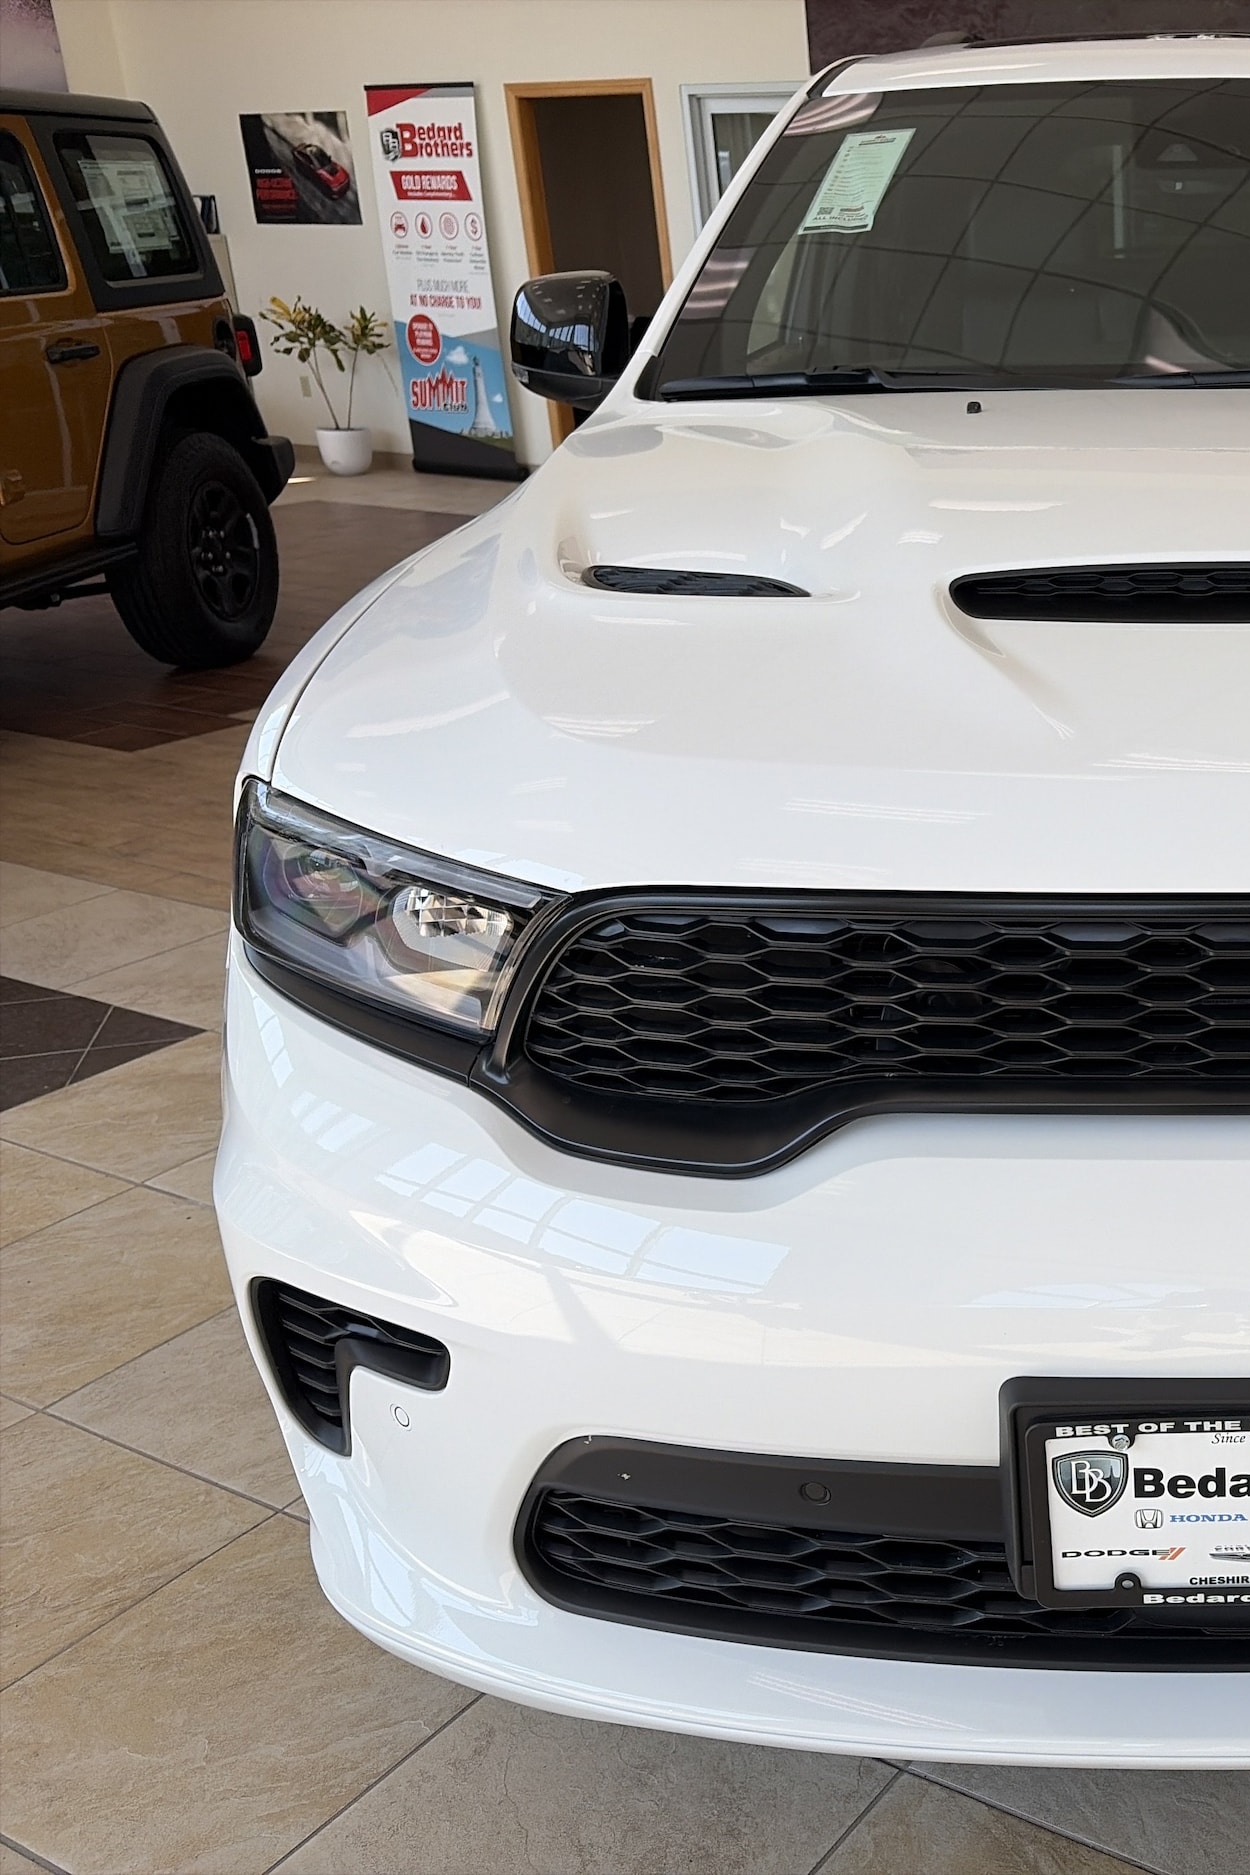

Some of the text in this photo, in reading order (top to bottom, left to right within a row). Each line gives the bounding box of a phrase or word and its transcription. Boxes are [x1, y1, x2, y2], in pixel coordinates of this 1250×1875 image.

[411, 366, 467, 408] SUMMIT
[1055, 1424, 1129, 1437] BEST
[1138, 1422, 1176, 1433] OF
[1184, 1420, 1242, 1432] THE
[1211, 1433, 1246, 1444] Since
[1169, 1514, 1249, 1523] HONDA
[1061, 1549, 1171, 1559] DODGE
